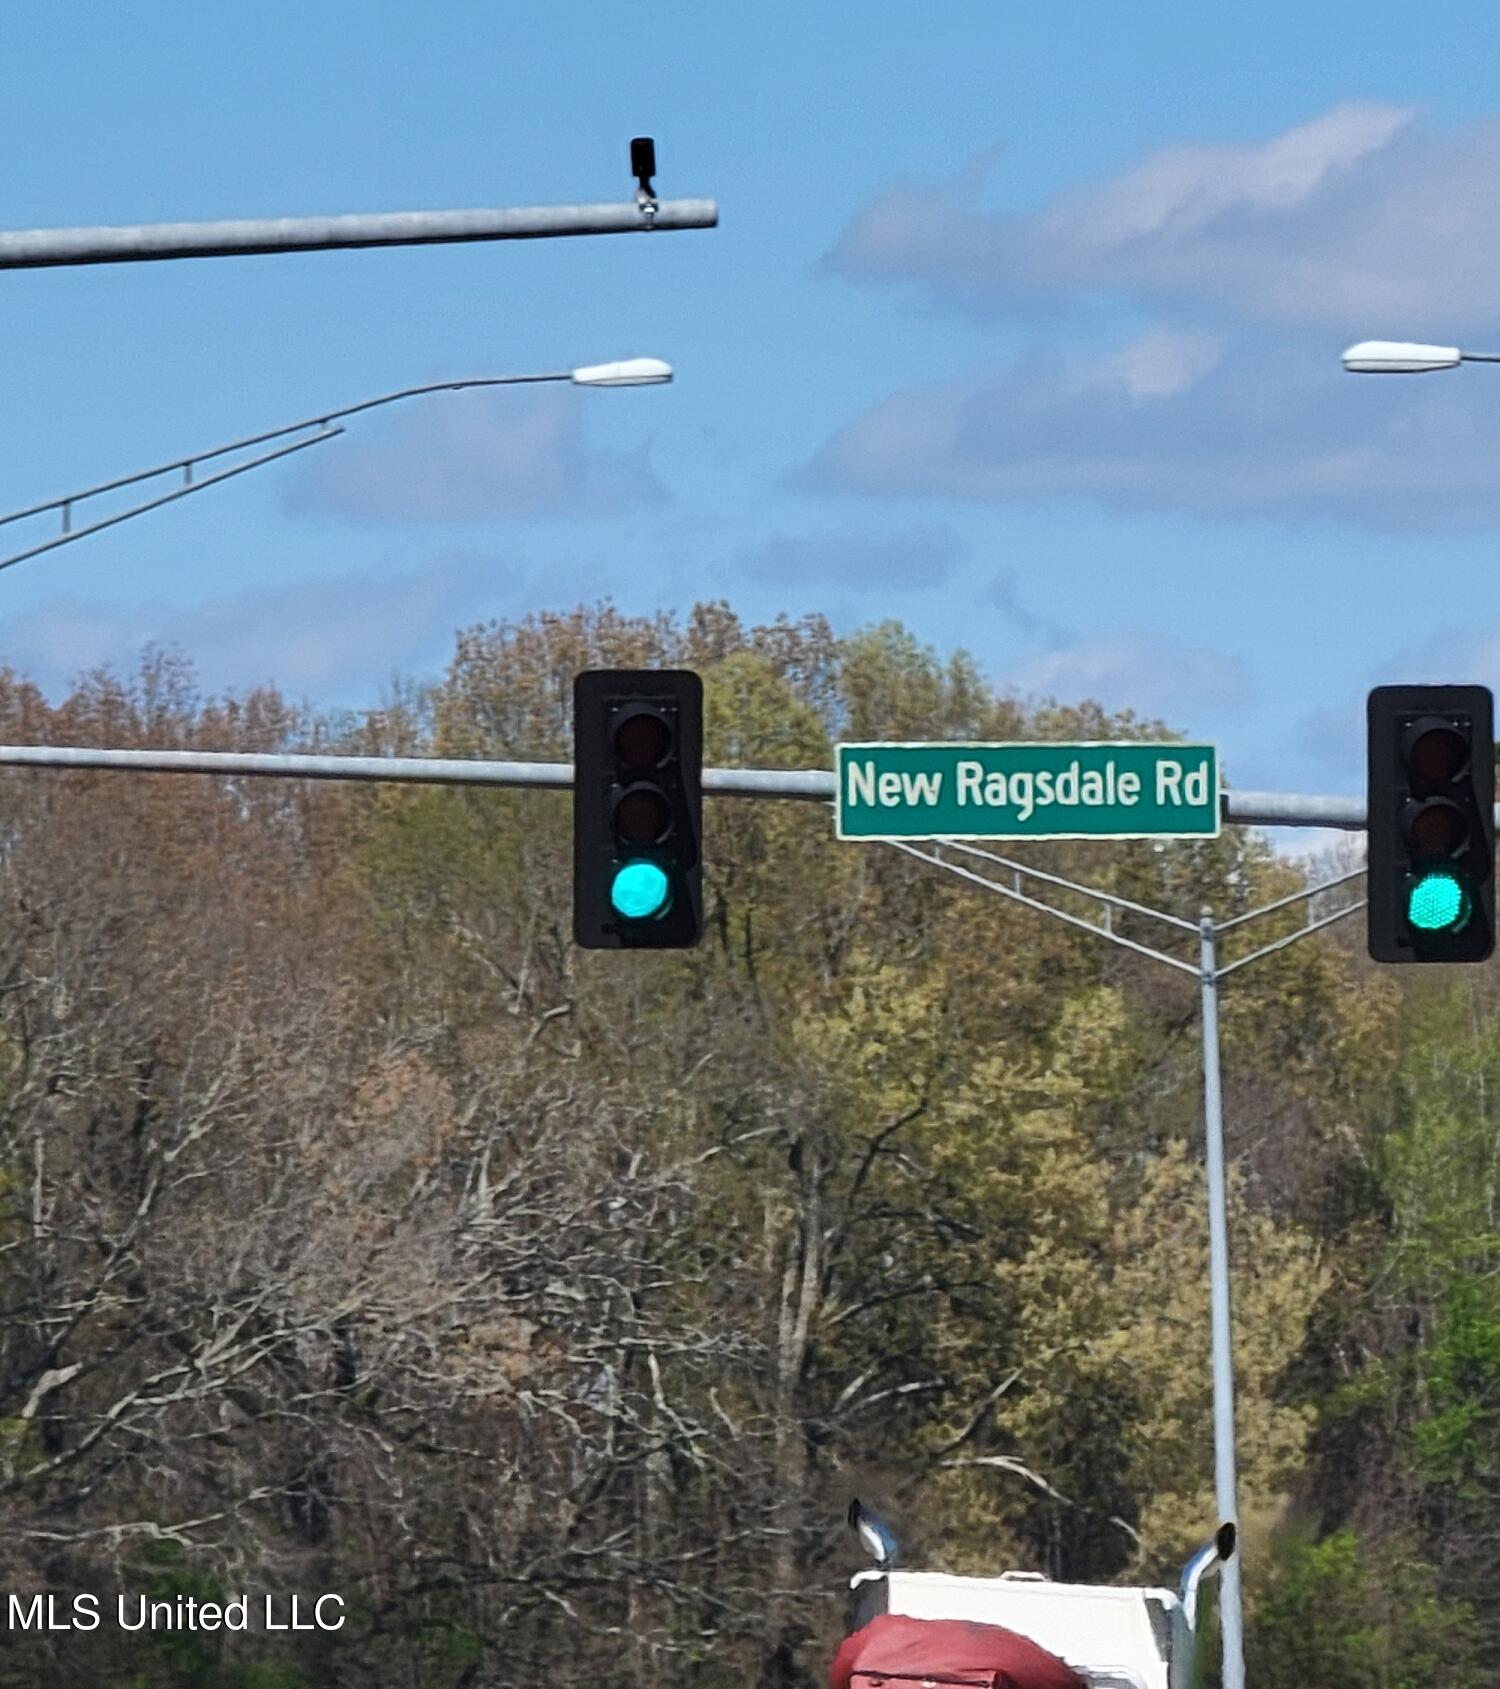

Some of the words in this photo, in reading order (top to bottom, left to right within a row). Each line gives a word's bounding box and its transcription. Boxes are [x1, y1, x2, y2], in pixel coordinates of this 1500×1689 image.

[847, 761, 942, 807] New
[956, 760, 1141, 822] Ragsdale
[1155, 760, 1208, 806] Rd
